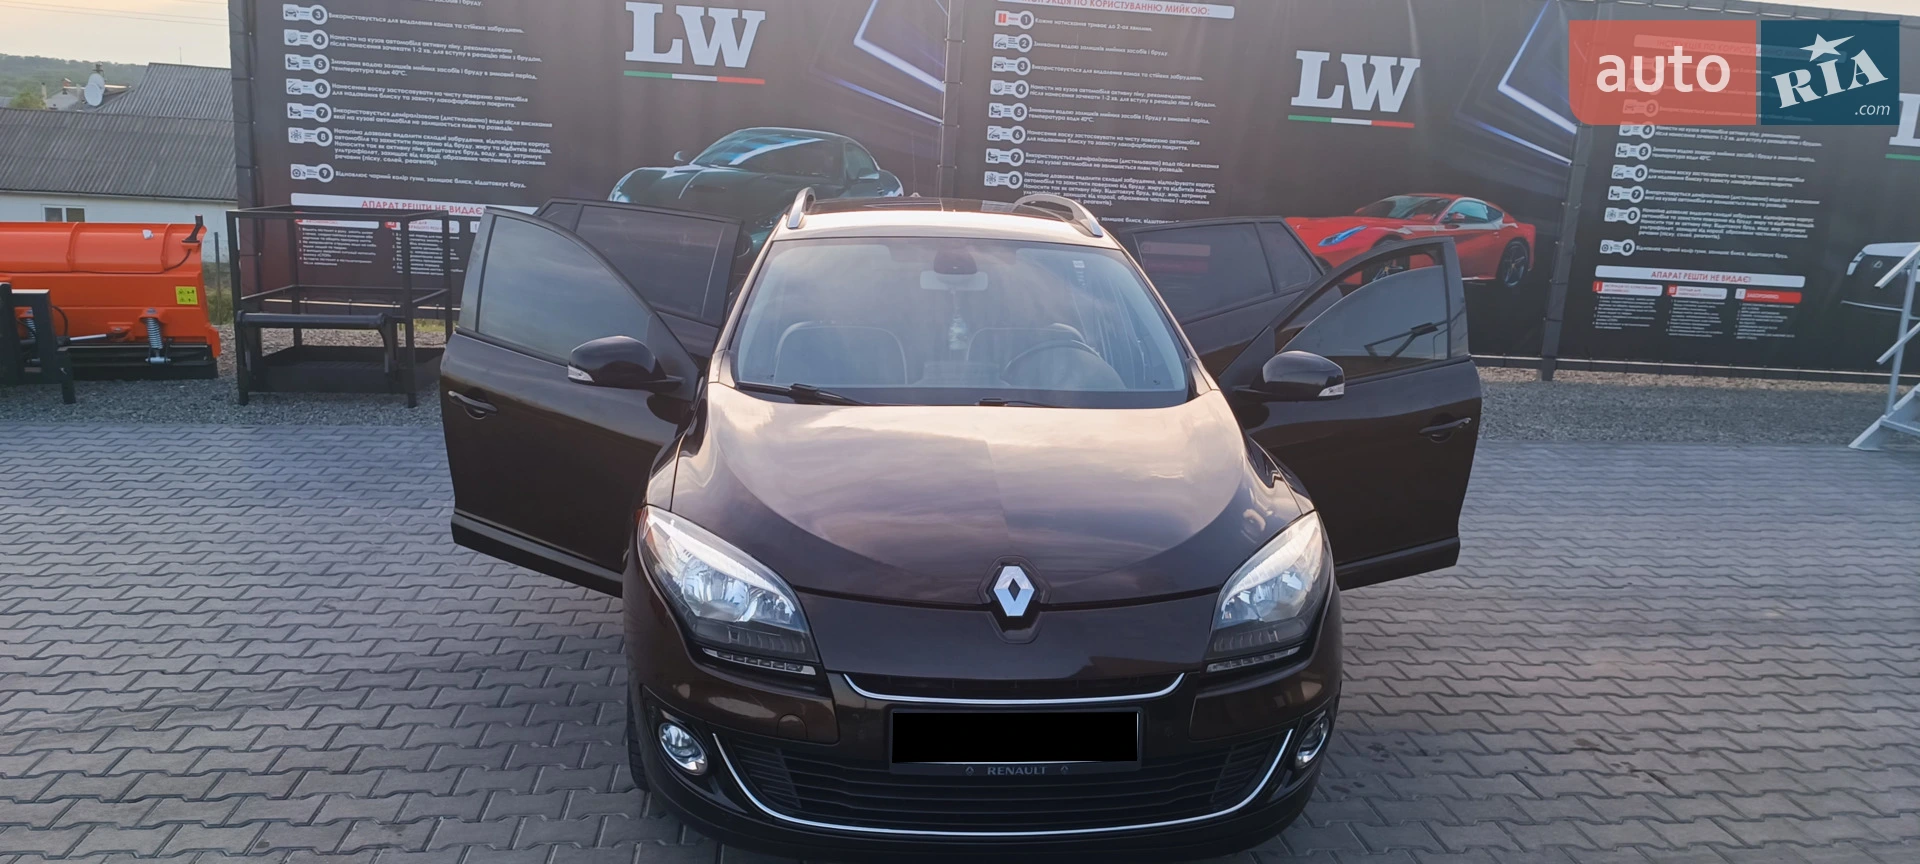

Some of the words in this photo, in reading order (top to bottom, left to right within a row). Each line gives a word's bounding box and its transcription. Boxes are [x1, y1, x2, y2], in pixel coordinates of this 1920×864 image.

[1089, 0, 1163, 11] КОРИСТУВАННЮ
[1165, 4, 1210, 15] МИЙКОЮ:
[625, 1, 765, 68] LW
[1291, 50, 1421, 112] LW
[362, 200, 399, 209] АПАРАТ
[402, 203, 432, 211] РЕШТИ
[1651, 271, 1682, 279] АПАРАТ
[987, 766, 1046, 776] RENAULT
